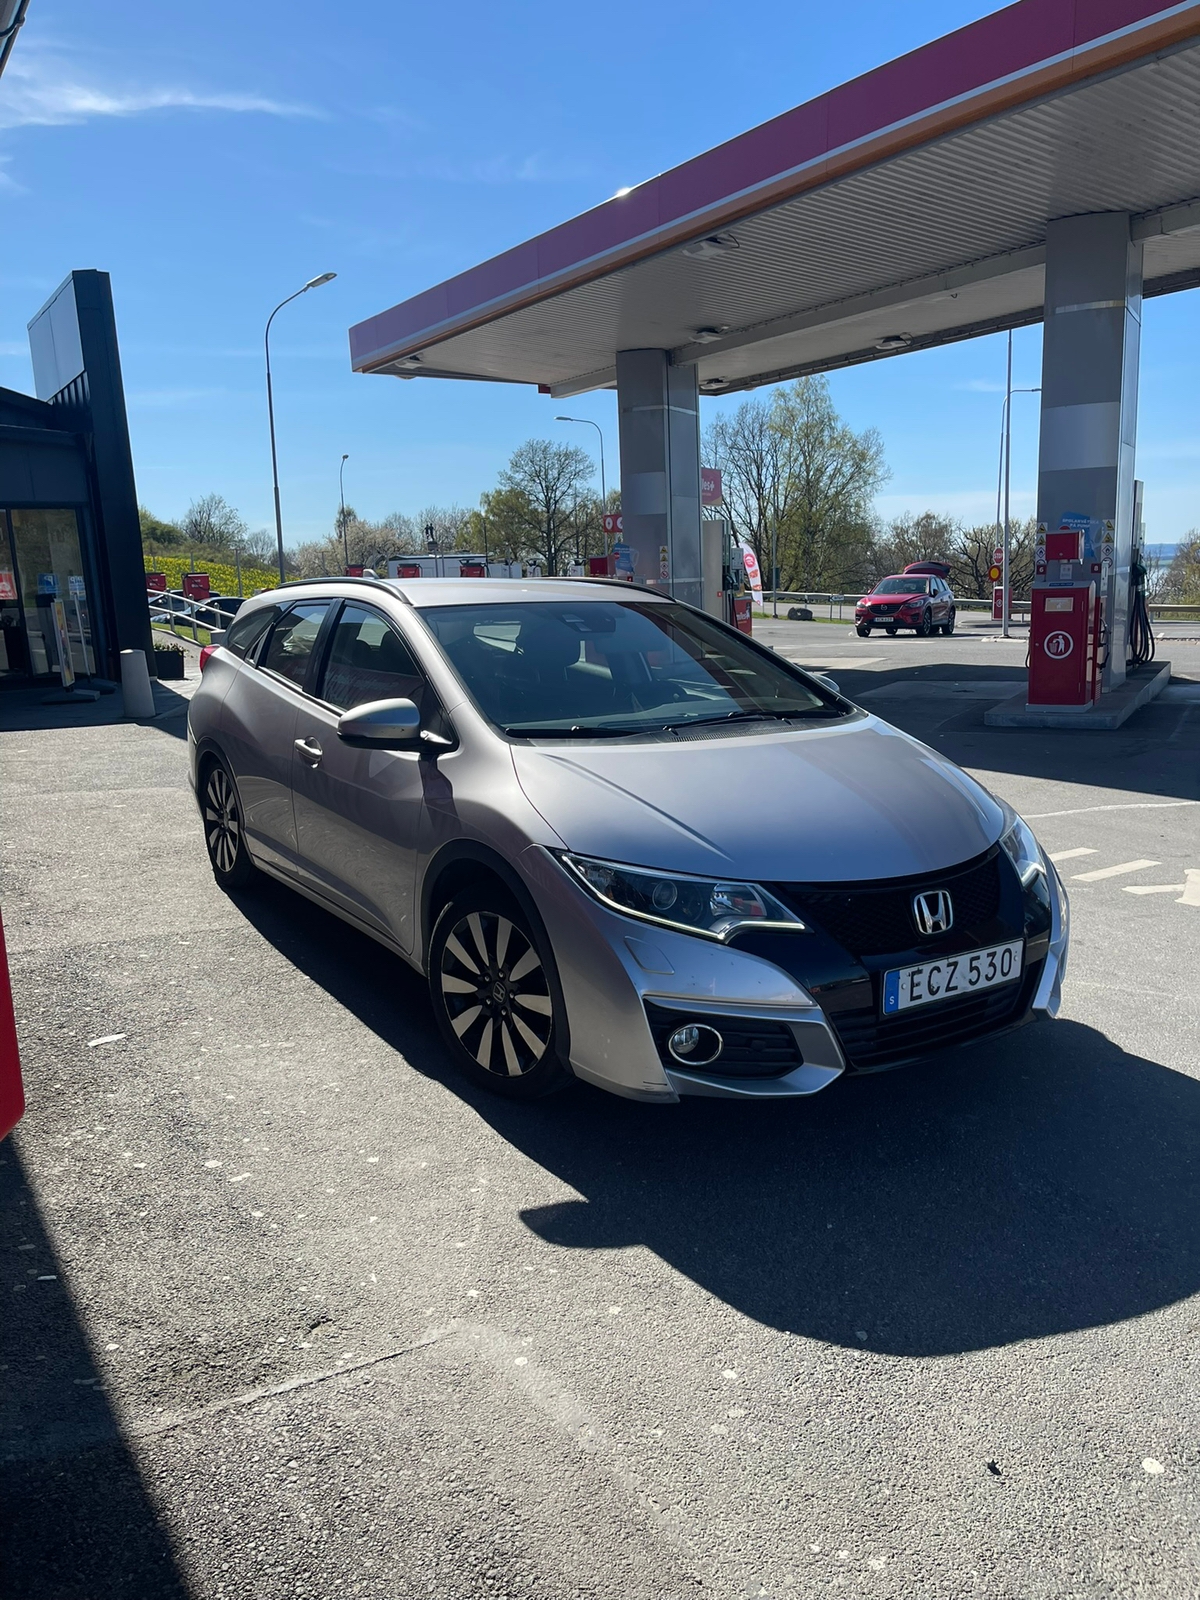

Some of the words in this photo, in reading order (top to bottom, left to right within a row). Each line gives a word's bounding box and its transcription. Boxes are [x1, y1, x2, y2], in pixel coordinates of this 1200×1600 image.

[909, 961, 959, 1002] ECZ
[968, 947, 1013, 986] 530
[889, 995, 895, 1005] S
